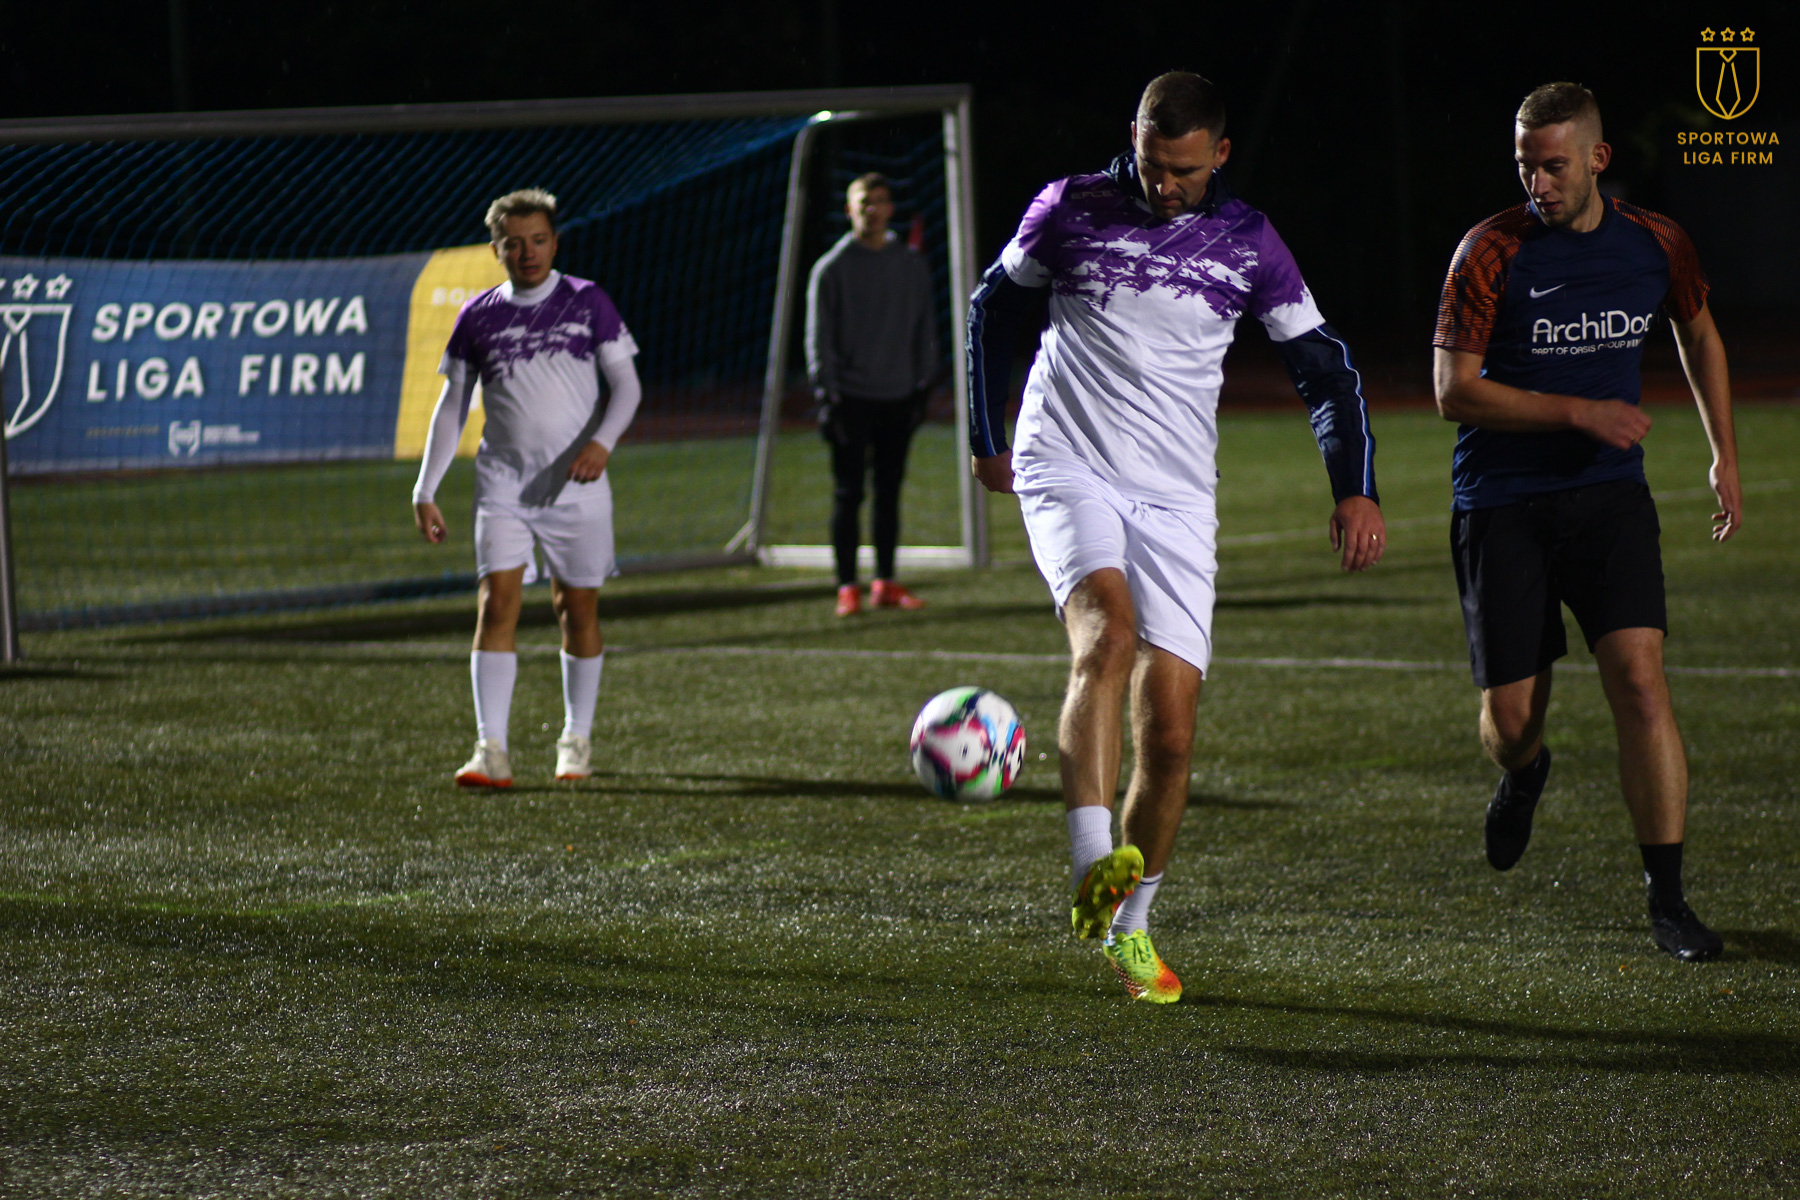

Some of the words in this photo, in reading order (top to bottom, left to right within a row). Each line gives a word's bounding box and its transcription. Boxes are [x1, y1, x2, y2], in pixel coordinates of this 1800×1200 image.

[91, 295, 368, 341] SPORTOWA
[1555, 346, 1569, 355] OF
[1570, 344, 1596, 355] OASIS
[86, 357, 204, 402] LIGA
[238, 353, 366, 396] FIRM
